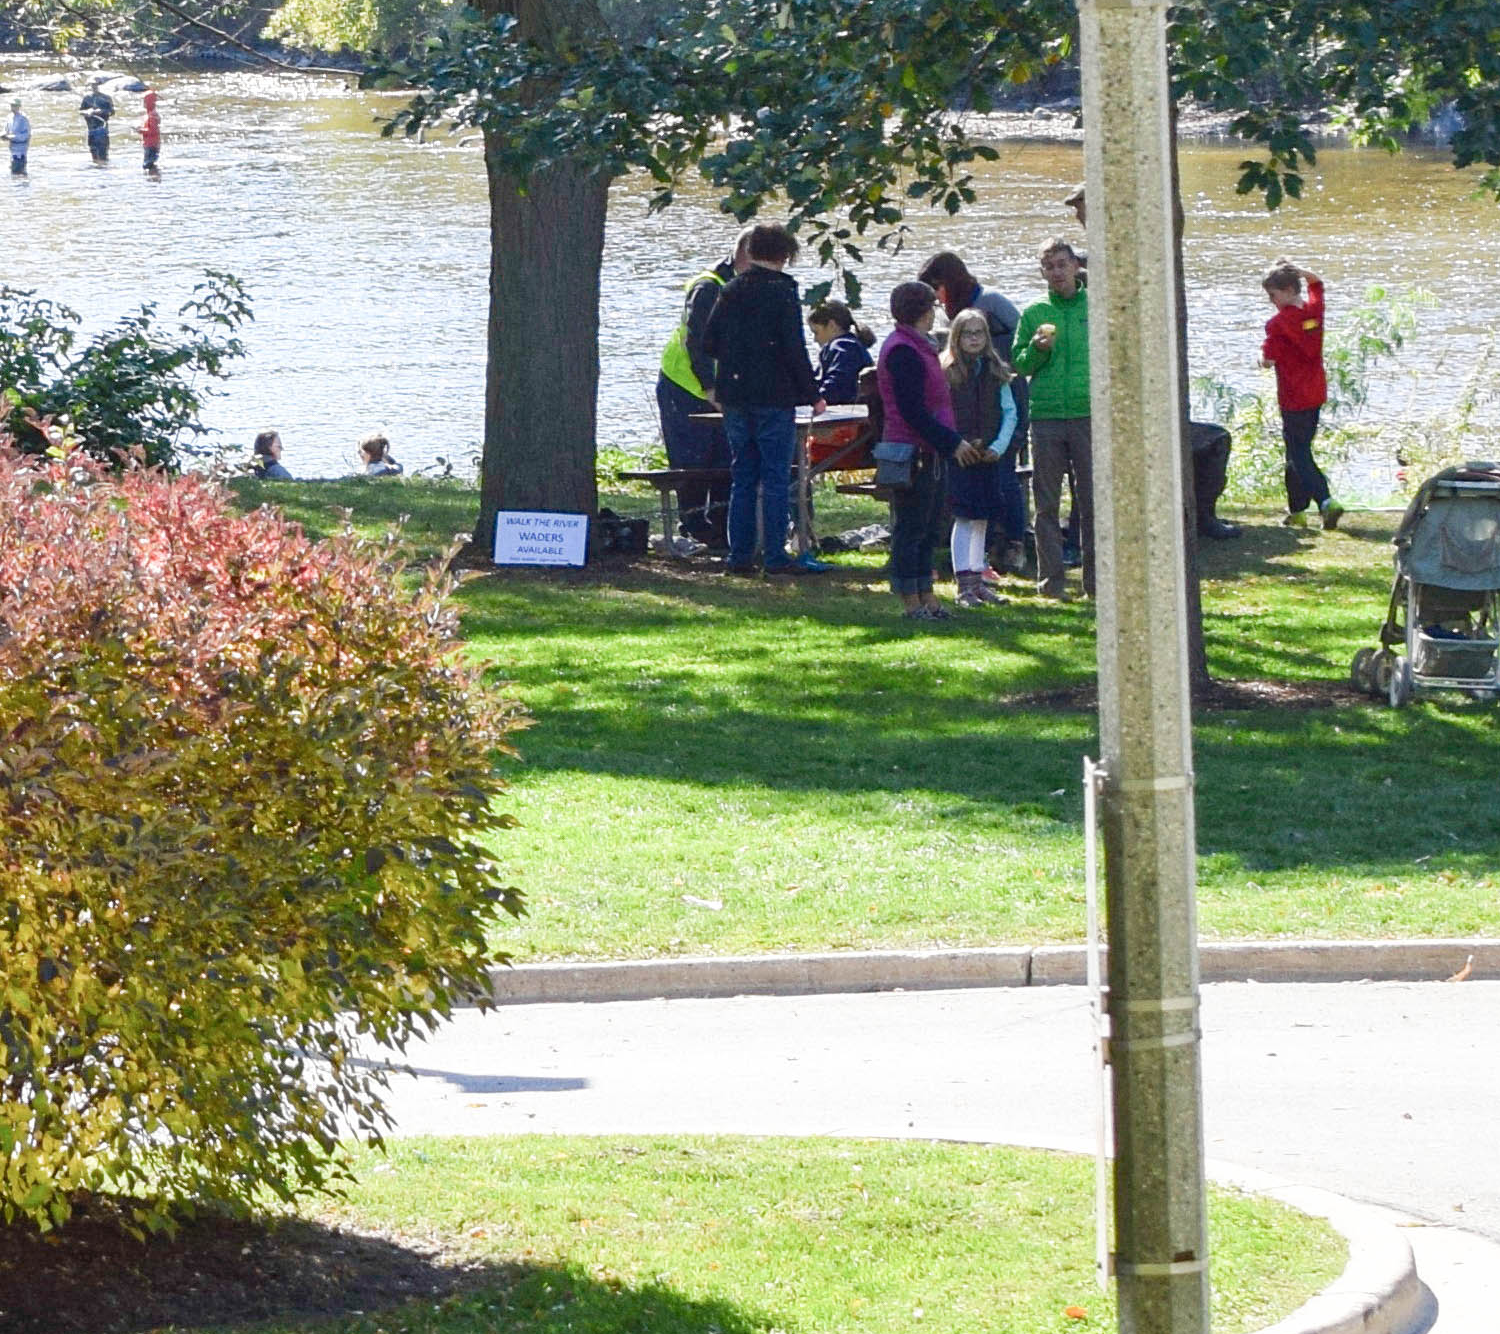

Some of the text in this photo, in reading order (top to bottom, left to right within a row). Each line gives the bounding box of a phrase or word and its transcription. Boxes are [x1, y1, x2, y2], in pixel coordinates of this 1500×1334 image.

[506, 517, 580, 528] WALK THE RIVER
[519, 532, 564, 543] WADERS
[517, 545, 564, 555] AVAILABLE
